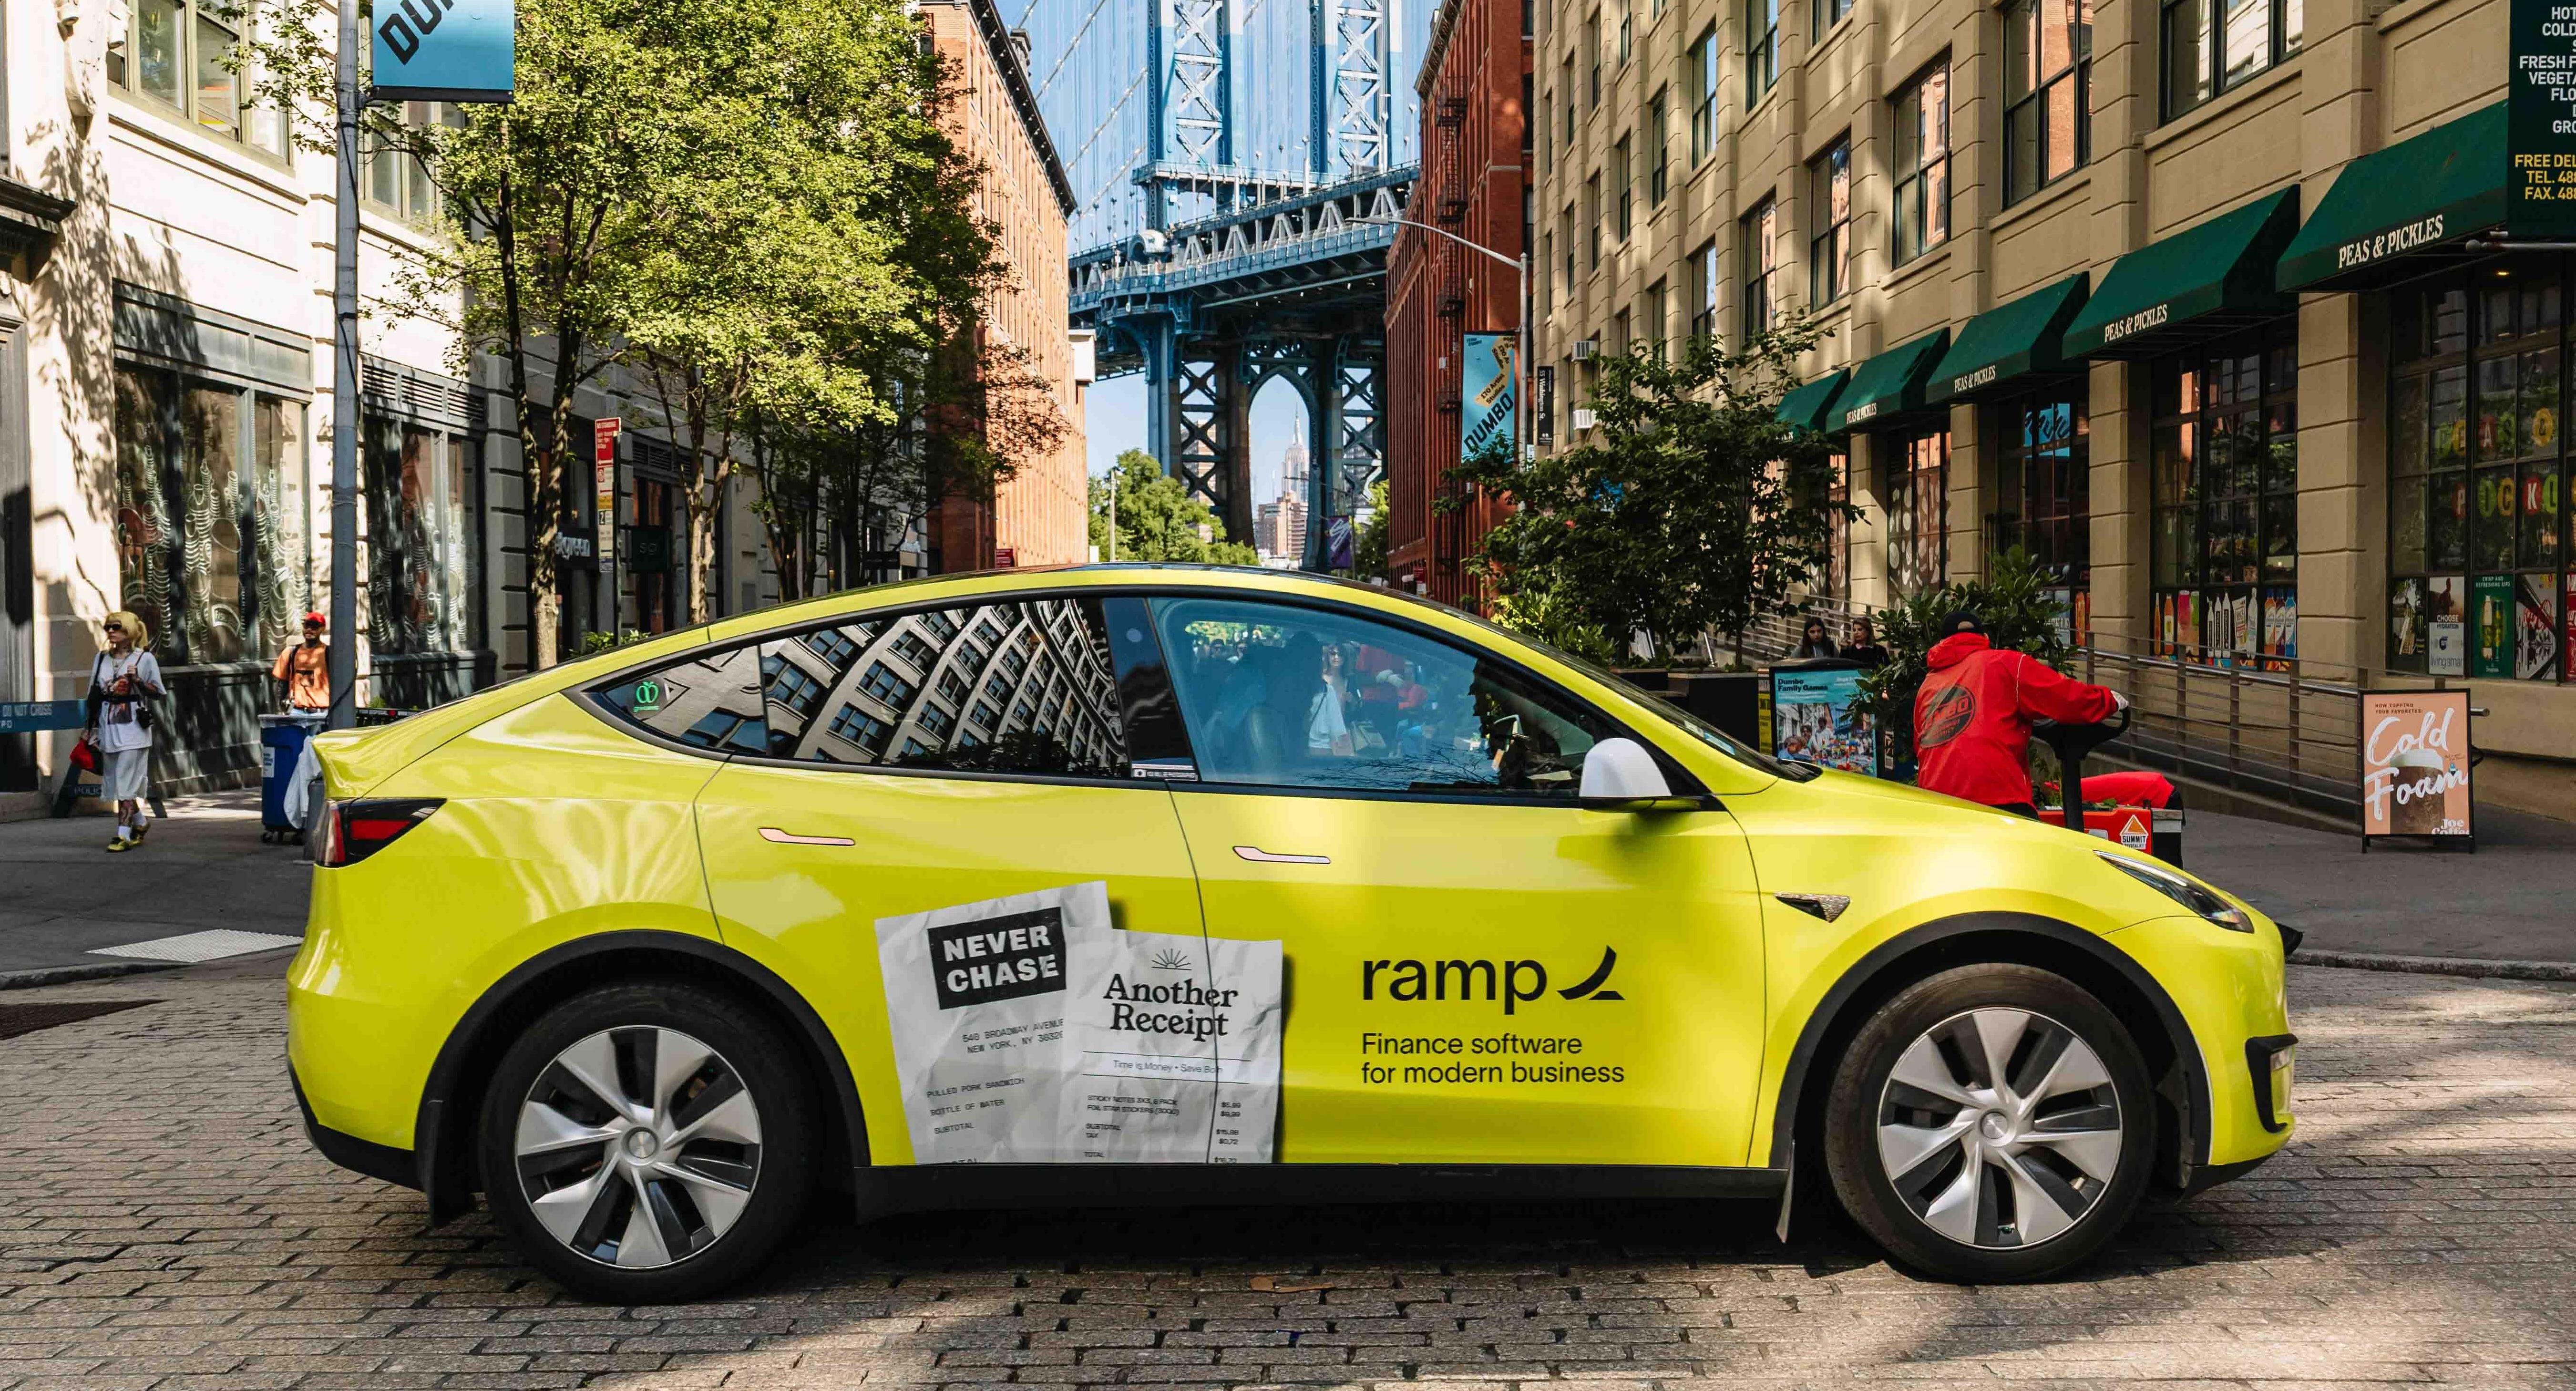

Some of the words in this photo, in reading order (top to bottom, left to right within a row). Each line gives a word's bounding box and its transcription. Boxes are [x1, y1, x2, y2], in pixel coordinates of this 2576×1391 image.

[2552, 7, 2576, 20] HOT
[2542, 23, 2576, 36] COLD
[2519, 55, 2566, 69] FRESH
[2551, 88, 2576, 101] FLO
[2515, 154, 2551, 167] FREE
[2526, 170, 2555, 183] TEL.
[2557, 170, 2576, 183] 48
[2525, 187, 2555, 199] FAX.
[2557, 187, 2576, 199] 48
[2339, 239, 2370, 268] PEAS
[2372, 235, 2385, 258] &
[2387, 214, 2443, 254] PICKLES
[2105, 319, 2124, 342] PEAS
[2125, 317, 2133, 334] &
[2134, 304, 2167, 332] PICKLES
[1481, 389, 1491, 399] 170
[1490, 373, 1505, 390] Artist
[1954, 375, 1968, 393] PEAS
[1969, 374, 1973, 388] &
[1974, 365, 1995, 386] PICKLES
[1486, 384, 1505, 404] Studios
[1537, 378, 1546, 412] Washington
[1464, 392, 1513, 453] DUMBO
[1847, 410, 1856, 424] PEAS
[1861, 402, 1877, 420] PICKLES
[30, 704, 52, 716] CROSS
[2367, 707, 2454, 765] Cold
[2365, 767, 2468, 821] Foam
[2441, 818, 2464, 829] Joe
[943, 925, 1051, 961] NEVER
[946, 954, 1059, 992] CHASE
[1103, 974, 1238, 1007] Another
[1363, 959, 1547, 1015] ramp
[984, 1025, 1029, 1039] BROADWAY
[1110, 1003, 1229, 1042] Receipt
[967, 1044, 985, 1053] NEW
[1022, 1036, 1033, 1044] NY
[1363, 1032, 1464, 1054] Finance
[1471, 1032, 1583, 1054] software
[1113, 1060, 1133, 1069] Time
[1144, 1062, 1173, 1072] Money
[1180, 1064, 1201, 1072] Save
[1362, 1061, 1396, 1083] for
[1404, 1061, 1503, 1083] modern
[1511, 1061, 1625, 1083] business
[927, 1087, 957, 1097] PULLED
[961, 1084, 982, 1092] PORK
[985, 1078, 1025, 1088] SANDWICH
[930, 1105, 961, 1116] BOTTLE
[980, 1099, 1005, 1108] WATER
[934, 1123, 975, 1134] SUBTOTAL
